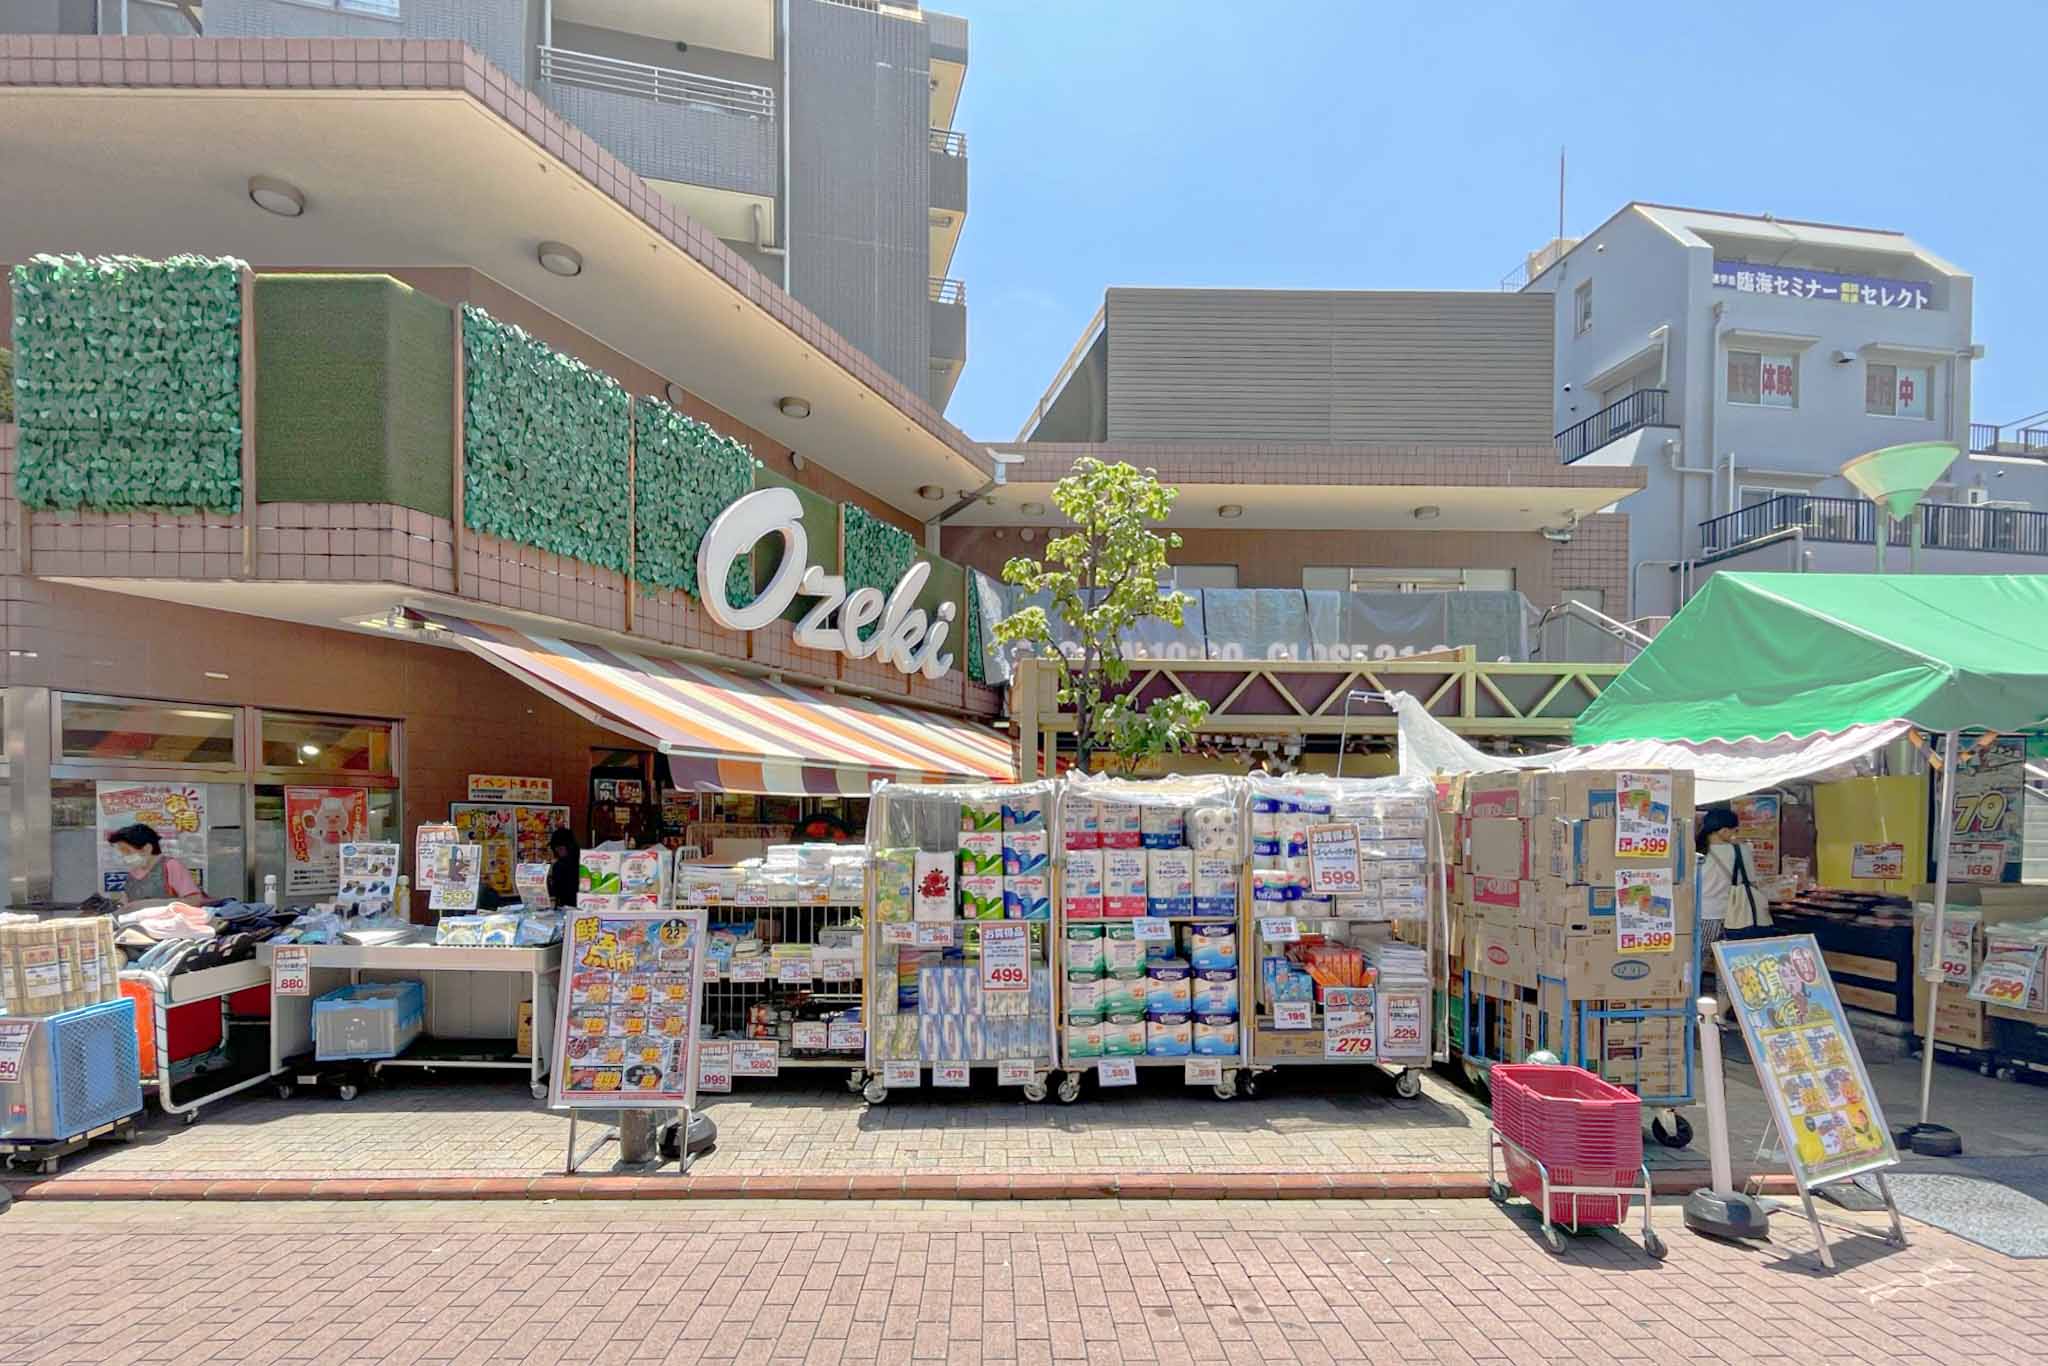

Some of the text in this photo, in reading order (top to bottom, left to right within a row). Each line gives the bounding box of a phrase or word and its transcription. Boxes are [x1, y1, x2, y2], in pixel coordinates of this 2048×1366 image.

[1860, 285, 1928, 310] セレクト
[697, 487, 957, 680] Ozeki
[1640, 837, 1669, 852] 399
[1322, 870, 1355, 885] 599
[1643, 931, 1673, 947] 399
[991, 967, 1023, 982] 499
[281, 979, 304, 989] 880
[1336, 1037, 1372, 1052] 279
[704, 1074, 726, 1086] 999
